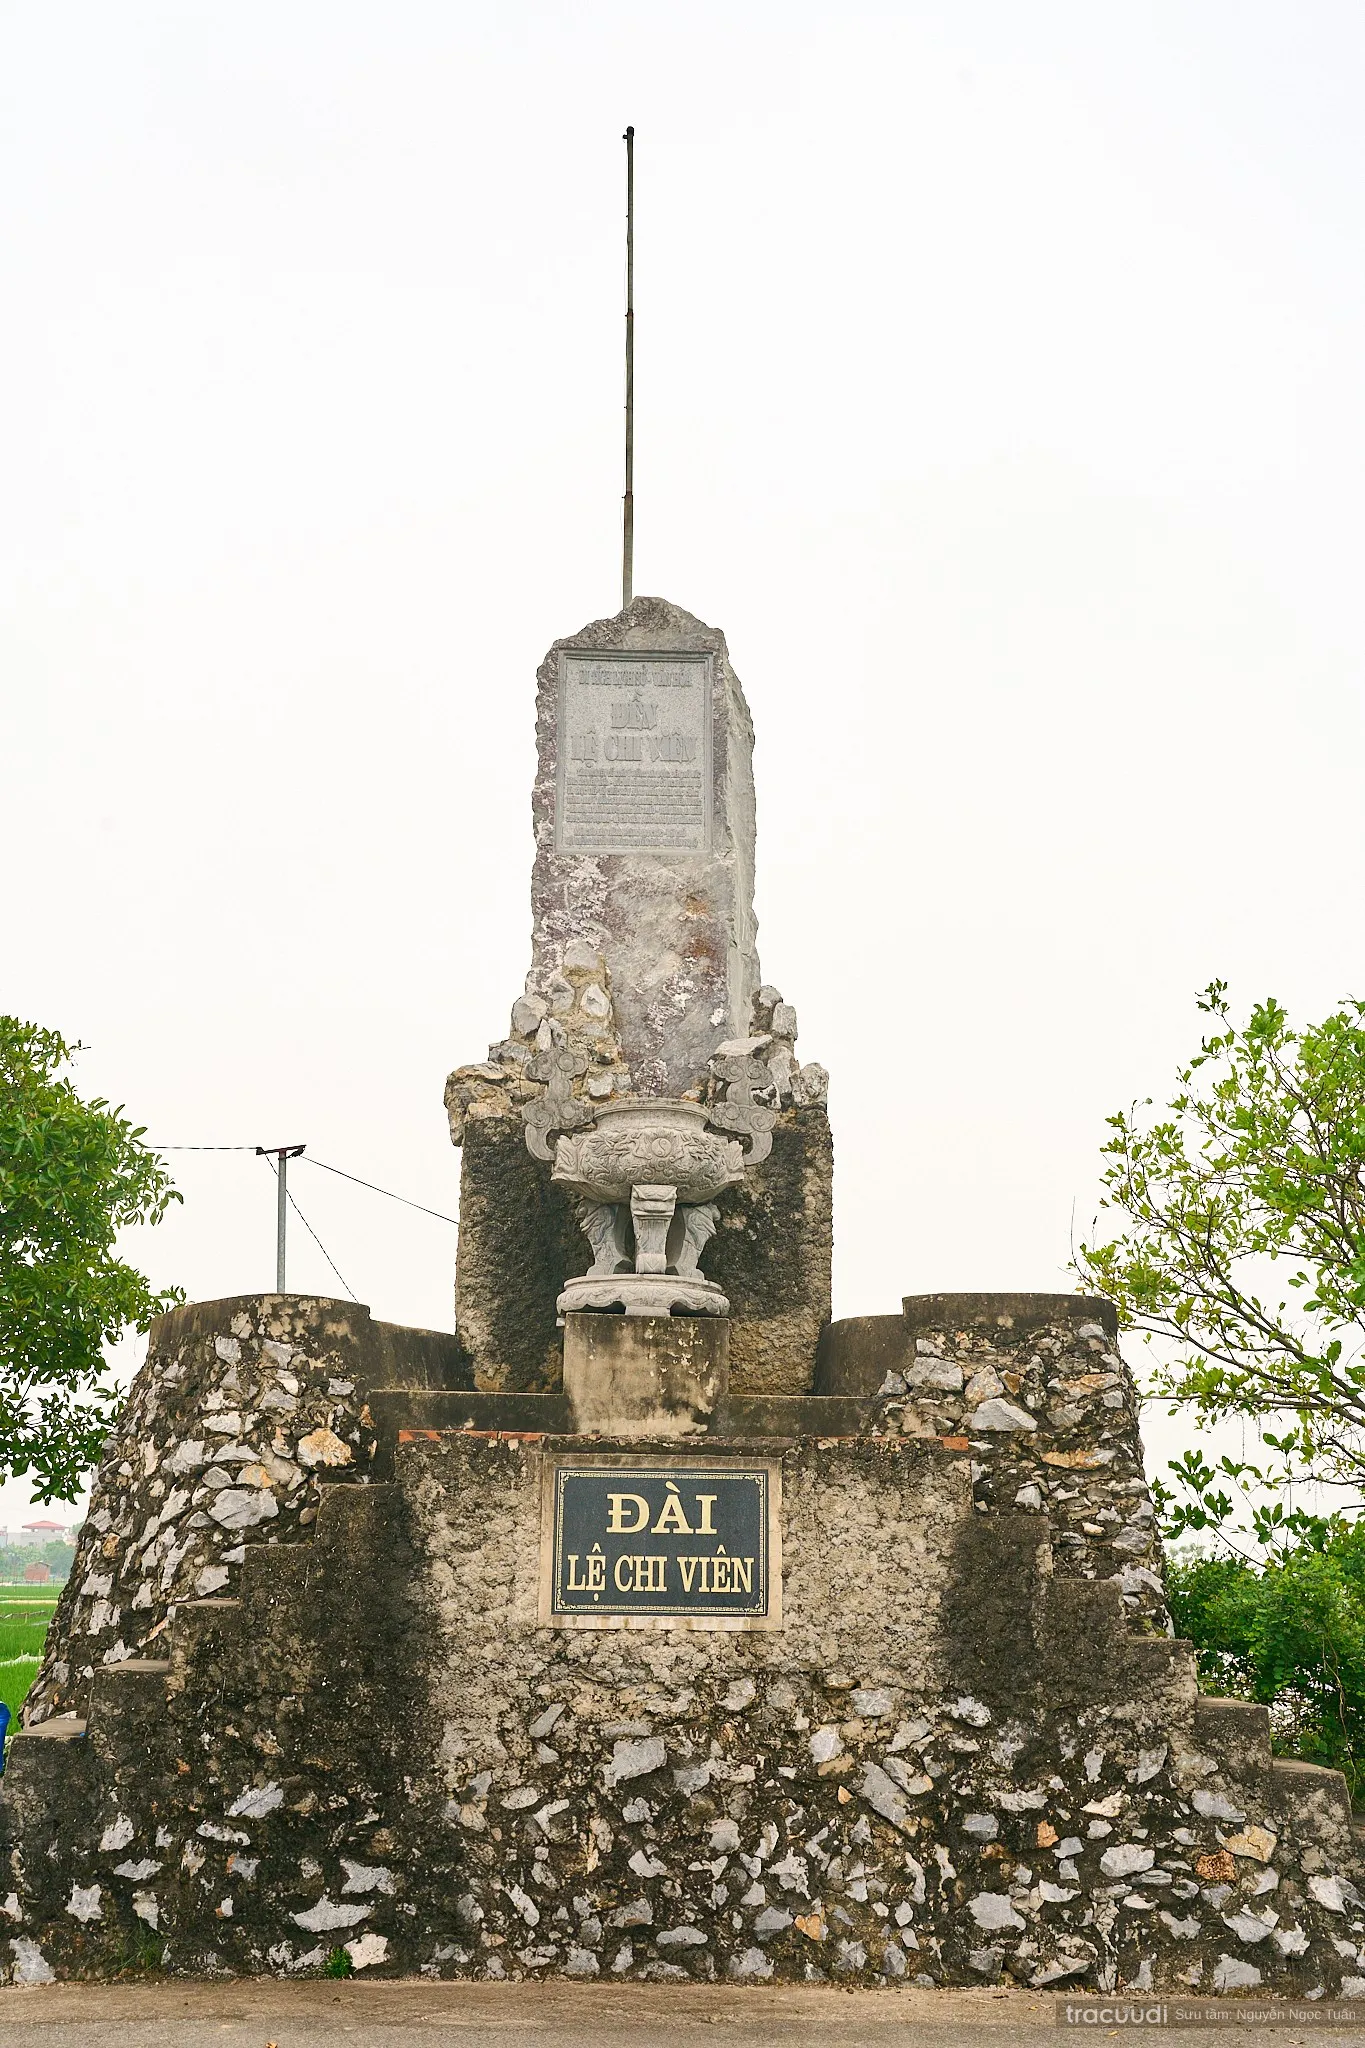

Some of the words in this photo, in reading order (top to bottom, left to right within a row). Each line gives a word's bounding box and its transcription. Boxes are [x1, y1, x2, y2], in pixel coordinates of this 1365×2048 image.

[570, 730, 598, 768] LỆ
[604, 735, 643, 762] CHI
[648, 731, 698, 764] VIÊN
[606, 1481, 718, 1535] ĐÀI
[567, 1543, 606, 1602] LỆ
[614, 1554, 668, 1592] CHI
[677, 1544, 755, 1593] VIÊN
